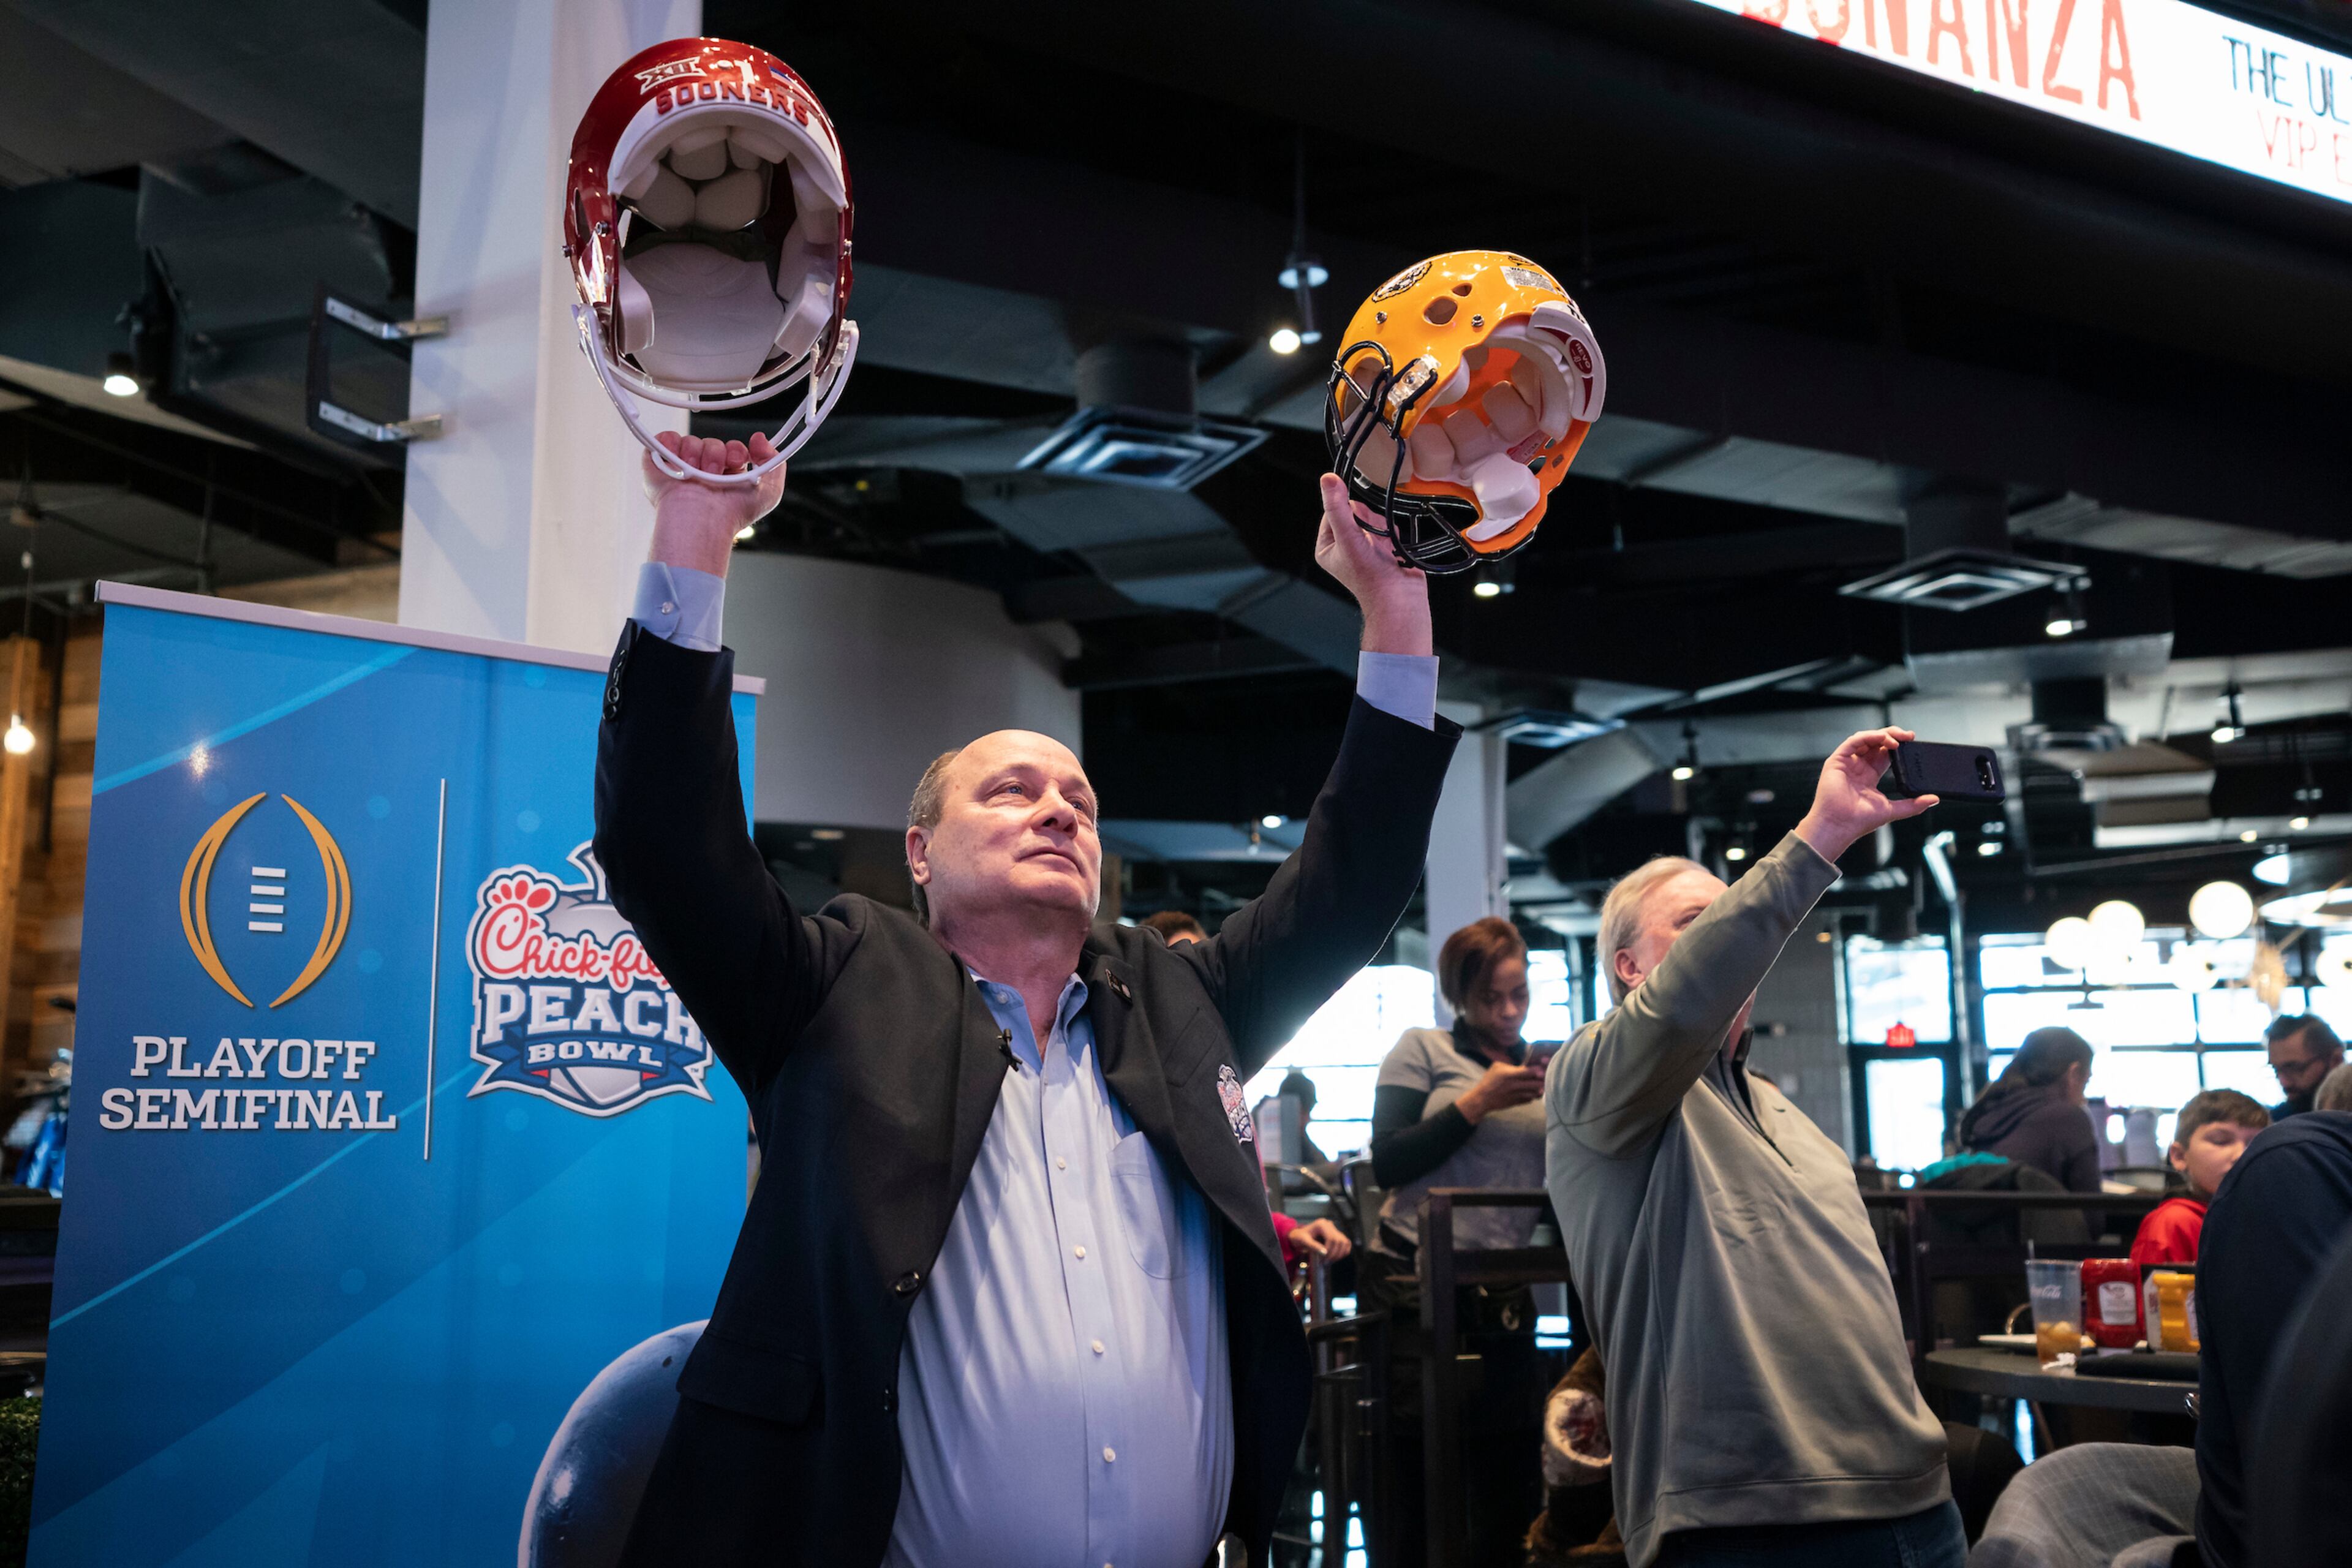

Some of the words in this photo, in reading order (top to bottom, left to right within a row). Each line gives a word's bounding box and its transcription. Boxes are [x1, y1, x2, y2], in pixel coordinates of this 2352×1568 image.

[1743, 0, 2141, 121] ANZA
[2222, 35, 2293, 107] THE
[2306, 61, 2352, 125] UL
[655, 80, 810, 126] SOONERS
[2257, 108, 2317, 170] VIP
[481, 903, 668, 988] Chick-fi
[481, 983, 703, 1052] PEACH
[130, 1036, 375, 1079] PLAYOFF
[527, 1041, 663, 1067] BOWL
[99, 1087, 397, 1129] SEMIFINAL
